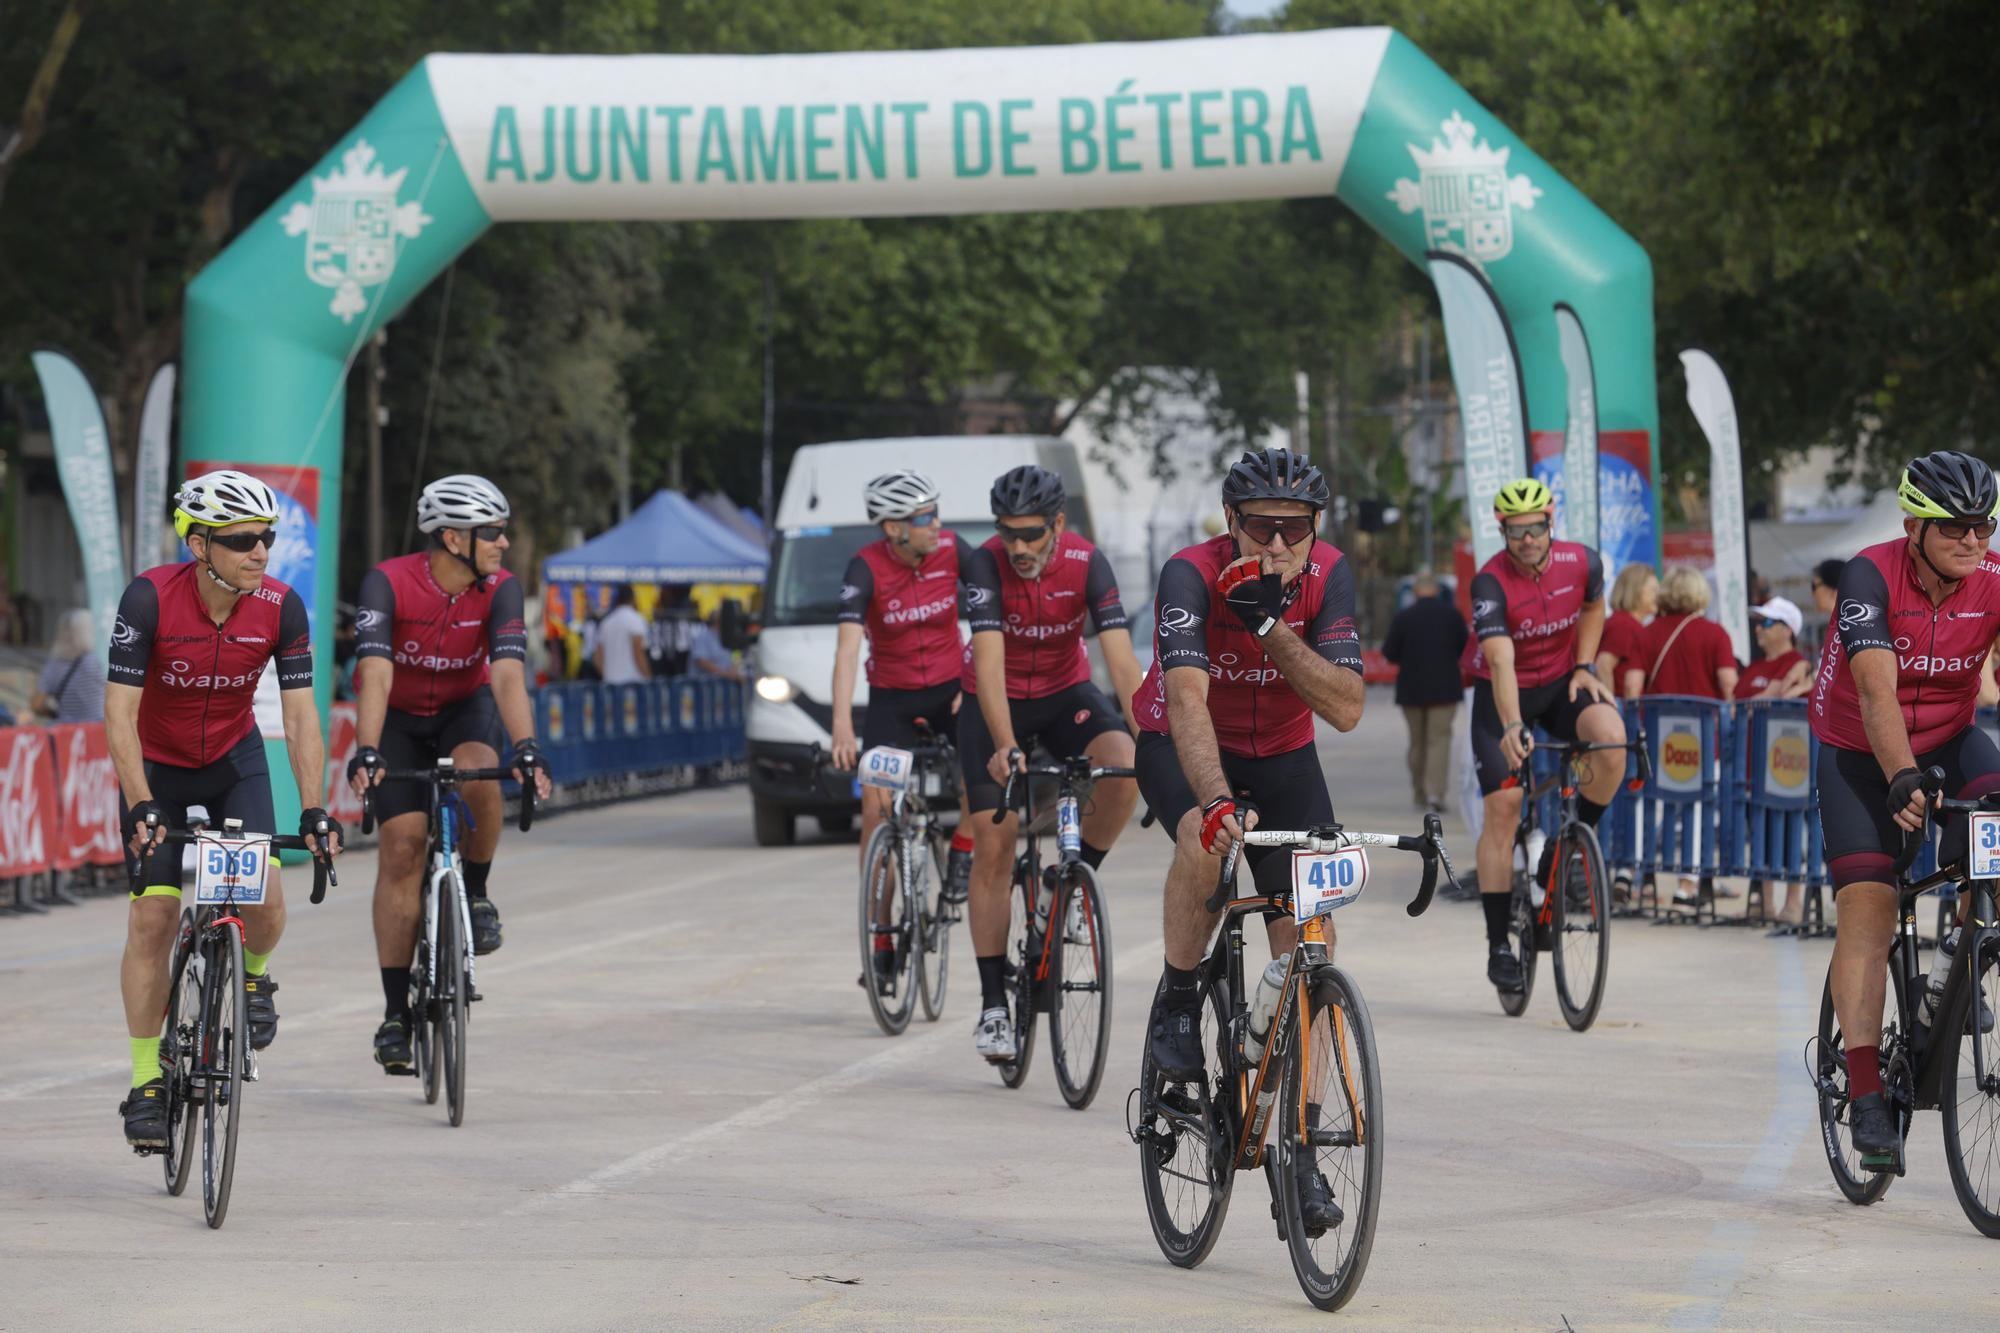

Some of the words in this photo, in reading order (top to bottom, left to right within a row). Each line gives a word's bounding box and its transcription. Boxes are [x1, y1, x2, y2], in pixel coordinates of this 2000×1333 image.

[486, 102, 929, 183] AJUNTAMENT
[953, 99, 1037, 178] DE
[1060, 78, 1322, 175] BÉTERA
[1815, 632, 1842, 717] avapace
[1899, 649, 1986, 677] vapace
[870, 753, 900, 775] 613
[1260, 830, 1296, 843] PRO
[1981, 822, 2000, 849] 3
[208, 849, 257, 877] 569
[1308, 858, 1354, 889] 410
[1272, 972, 1300, 1057] ORBEA
[1823, 1120, 1837, 1159] MAVIC
